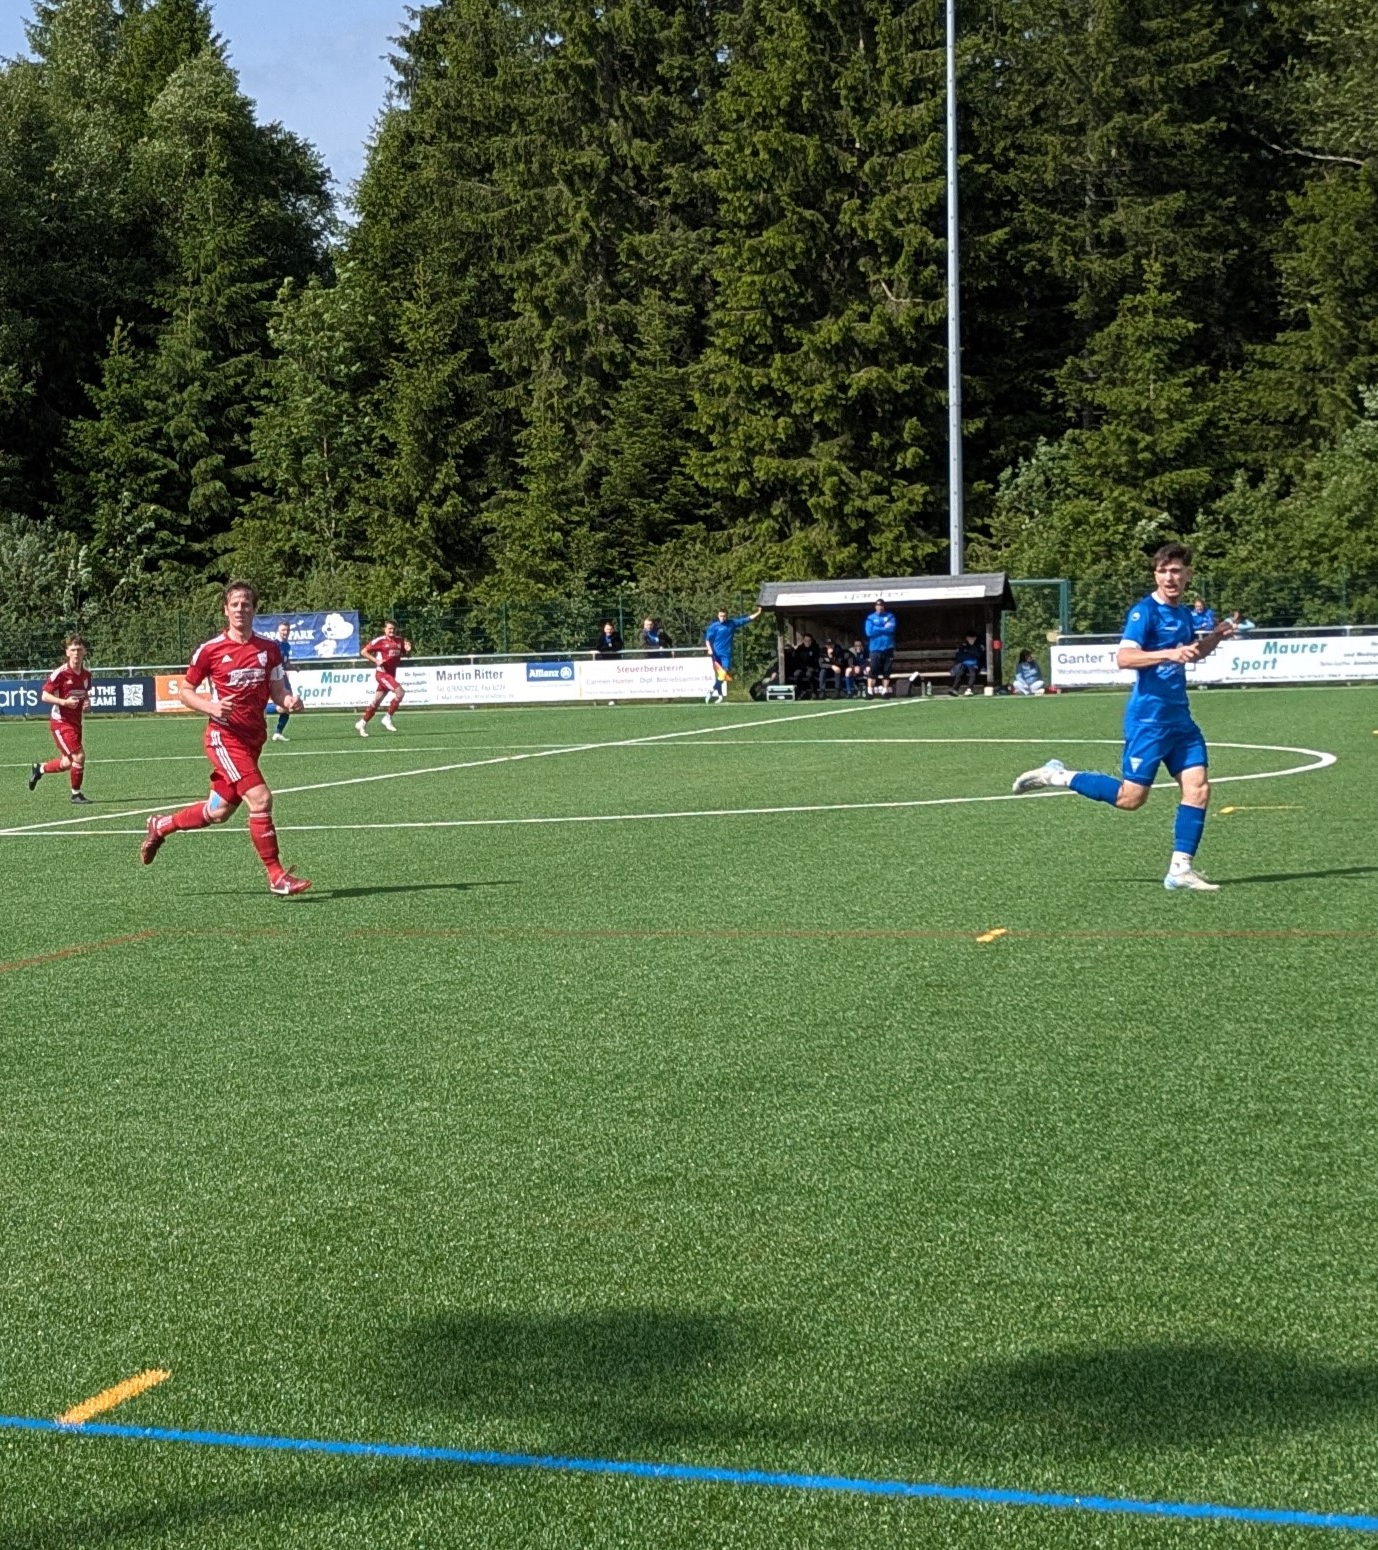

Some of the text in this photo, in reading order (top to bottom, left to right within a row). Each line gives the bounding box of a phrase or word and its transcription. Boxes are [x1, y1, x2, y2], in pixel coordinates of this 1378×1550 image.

[288, 630, 315, 640] PARK
[1262, 641, 1328, 655] Maurer
[1058, 653, 1104, 665] Ganter
[616, 665, 684, 673] Steuerberaterin
[1231, 657, 1277, 674] Sport
[321, 672, 371, 684] Maurer
[436, 668, 504, 681] Martin Ritter
[529, 668, 560, 678] Allianz
[97, 685, 117, 696] THE
[297, 686, 332, 700] Sport
